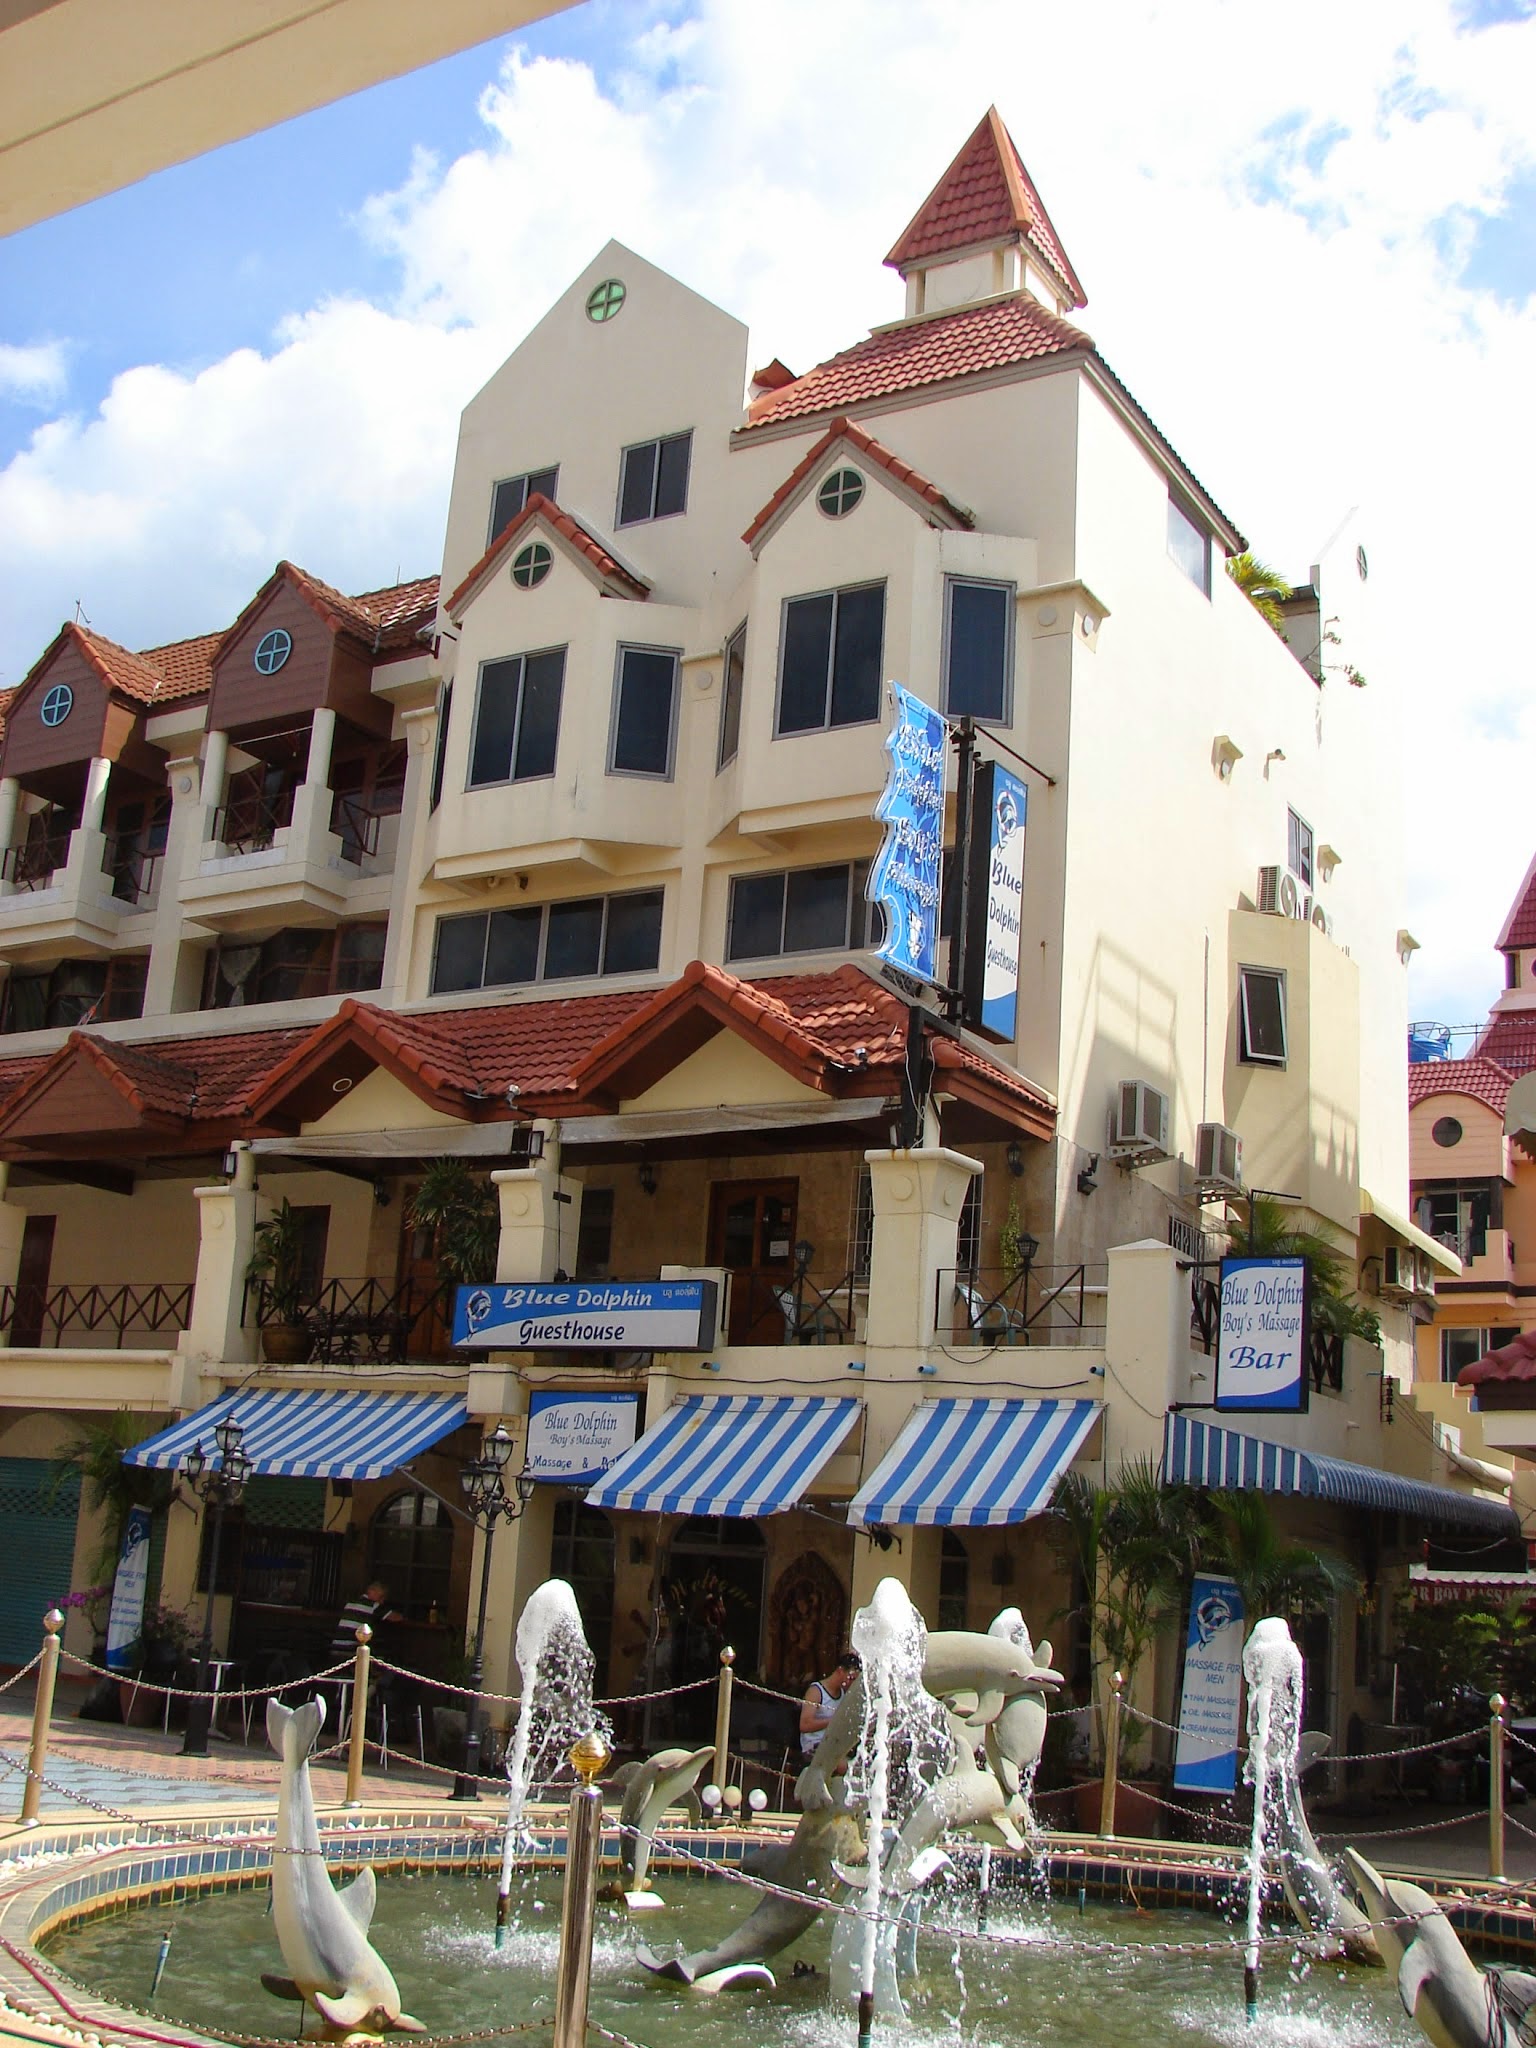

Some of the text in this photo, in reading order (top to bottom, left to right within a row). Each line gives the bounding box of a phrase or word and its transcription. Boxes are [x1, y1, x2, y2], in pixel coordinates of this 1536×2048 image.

[991, 858, 1022, 895] Blue
[989, 896, 1019, 936] Dolphin
[987, 940, 1017, 977] Guesthouse
[502, 1288, 653, 1311] Blue Dolphin
[1221, 1277, 1303, 1315] Blue Dolphin
[520, 1320, 625, 1345] Guesthouse
[1223, 1311, 1300, 1339] Boy's Massage
[1229, 1346, 1292, 1369] Bar
[544, 1410, 618, 1436] Blue Dolphin
[549, 1434, 612, 1449] Boy's Massage
[532, 1455, 573, 1471] Massage
[582, 1457, 589, 1469] &
[1186, 1658, 1240, 1674] MASSAGE FOR
[1205, 1673, 1225, 1685] MEN
[1206, 1694, 1237, 1706] MASSAGE
[1187, 1708, 1232, 1720] OIL MASSAGE
[1185, 1723, 1237, 1737] CREAM MASSAGE
